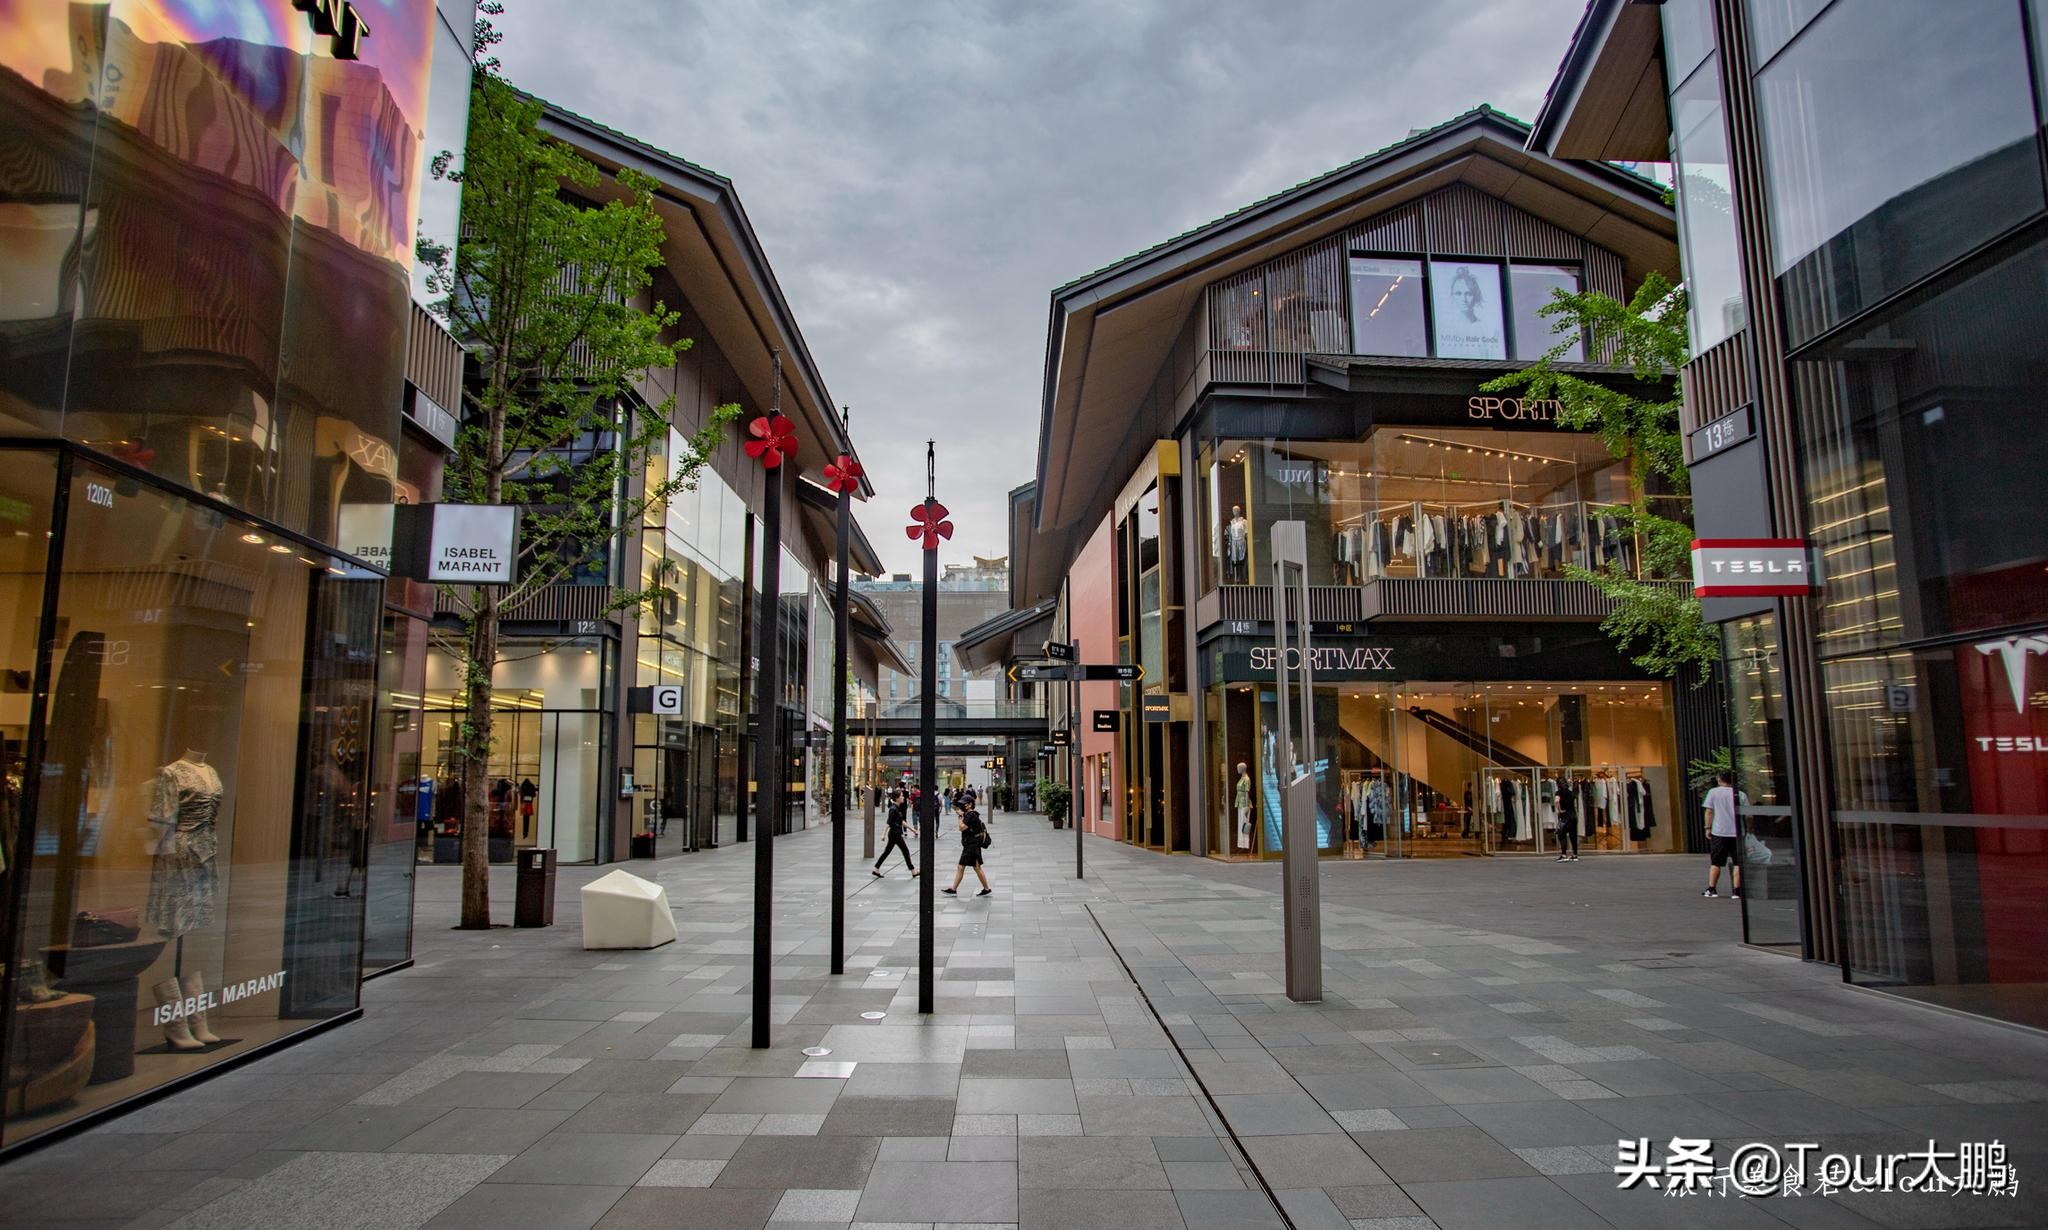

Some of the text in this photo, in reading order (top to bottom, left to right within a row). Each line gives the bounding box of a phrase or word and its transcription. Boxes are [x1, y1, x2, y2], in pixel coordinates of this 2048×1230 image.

[87, 482, 113, 508] 1207A
[444, 547, 496, 559] ISABEL
[438, 561, 502, 573] MARANT
[1710, 560, 1802, 573] TESLA
[1250, 646, 1397, 670] SPORTMAX
[658, 690, 677, 709] G
[1975, 736, 2048, 752] TESL
[153, 970, 287, 1026] ISABEL MARANT
